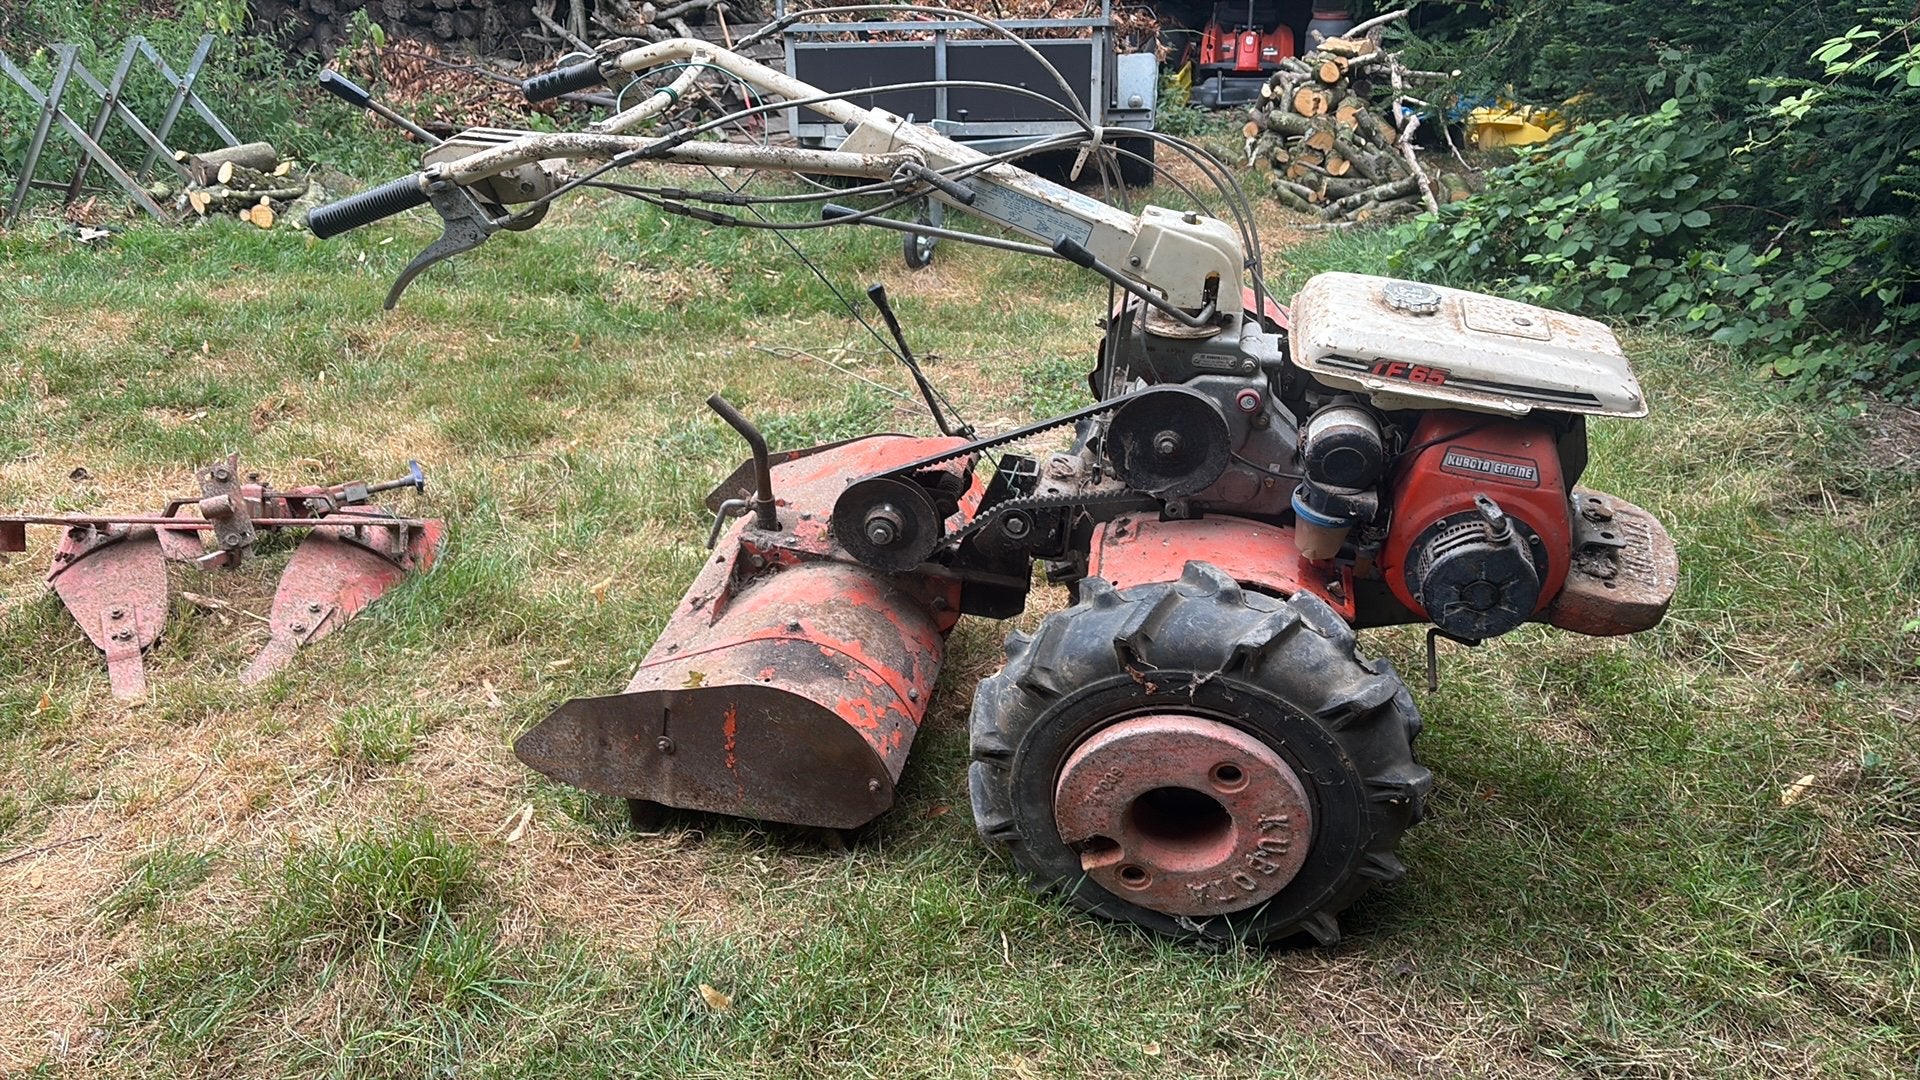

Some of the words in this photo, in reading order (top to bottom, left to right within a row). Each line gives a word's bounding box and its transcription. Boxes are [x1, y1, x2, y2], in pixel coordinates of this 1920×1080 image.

[1408, 365, 1450, 386] 65
[1446, 454, 1491, 472] KUBOTA
[1494, 463, 1533, 479] ENGINE
[1184, 813, 1289, 904] KUBOTA
